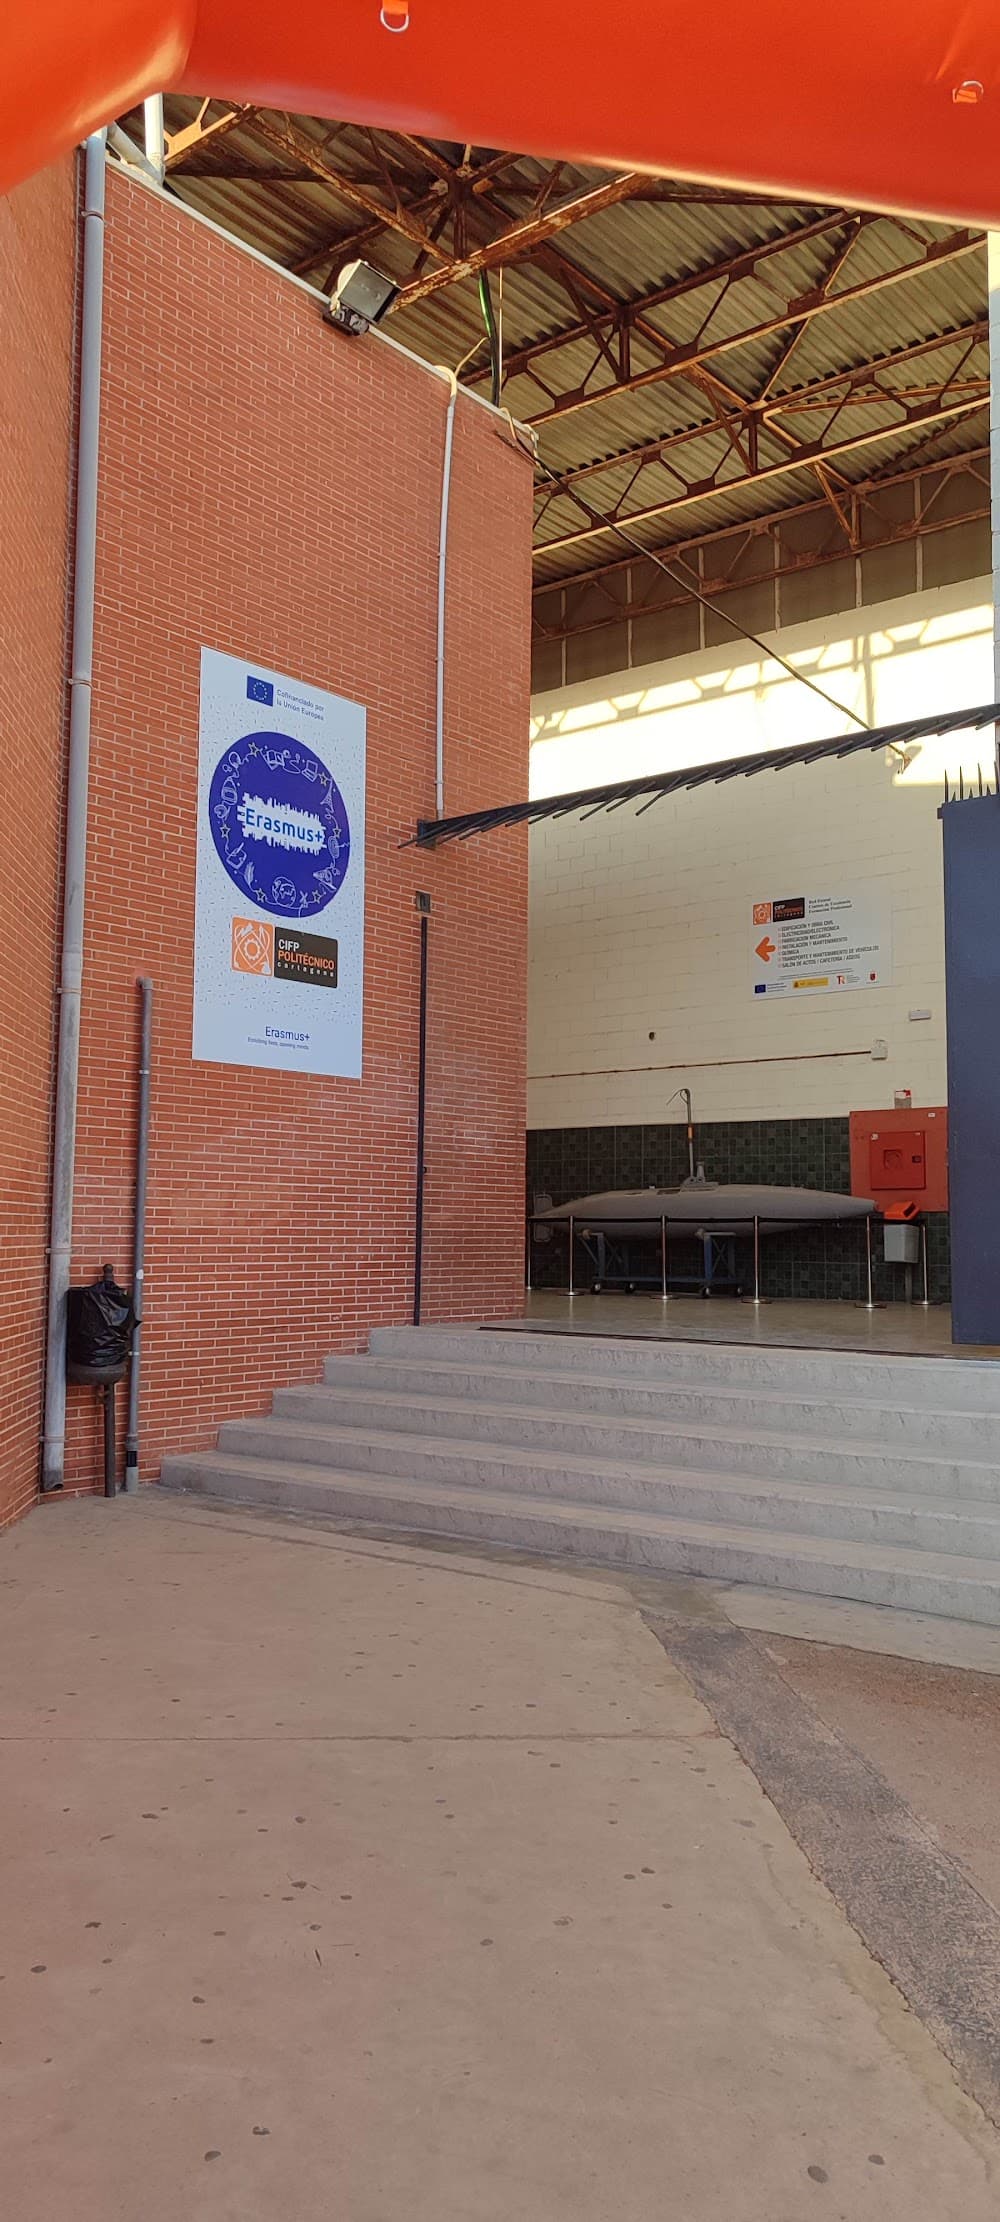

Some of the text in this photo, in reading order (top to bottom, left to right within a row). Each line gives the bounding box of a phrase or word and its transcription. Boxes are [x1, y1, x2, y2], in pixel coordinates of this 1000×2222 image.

[245, 808, 323, 843] Erasmus+
[278, 939, 300, 952] CIFP
[278, 950, 335, 970] POLITÉCNICO
[277, 961, 334, 977] cartagena
[265, 1026, 310, 1042] Erasmus+
